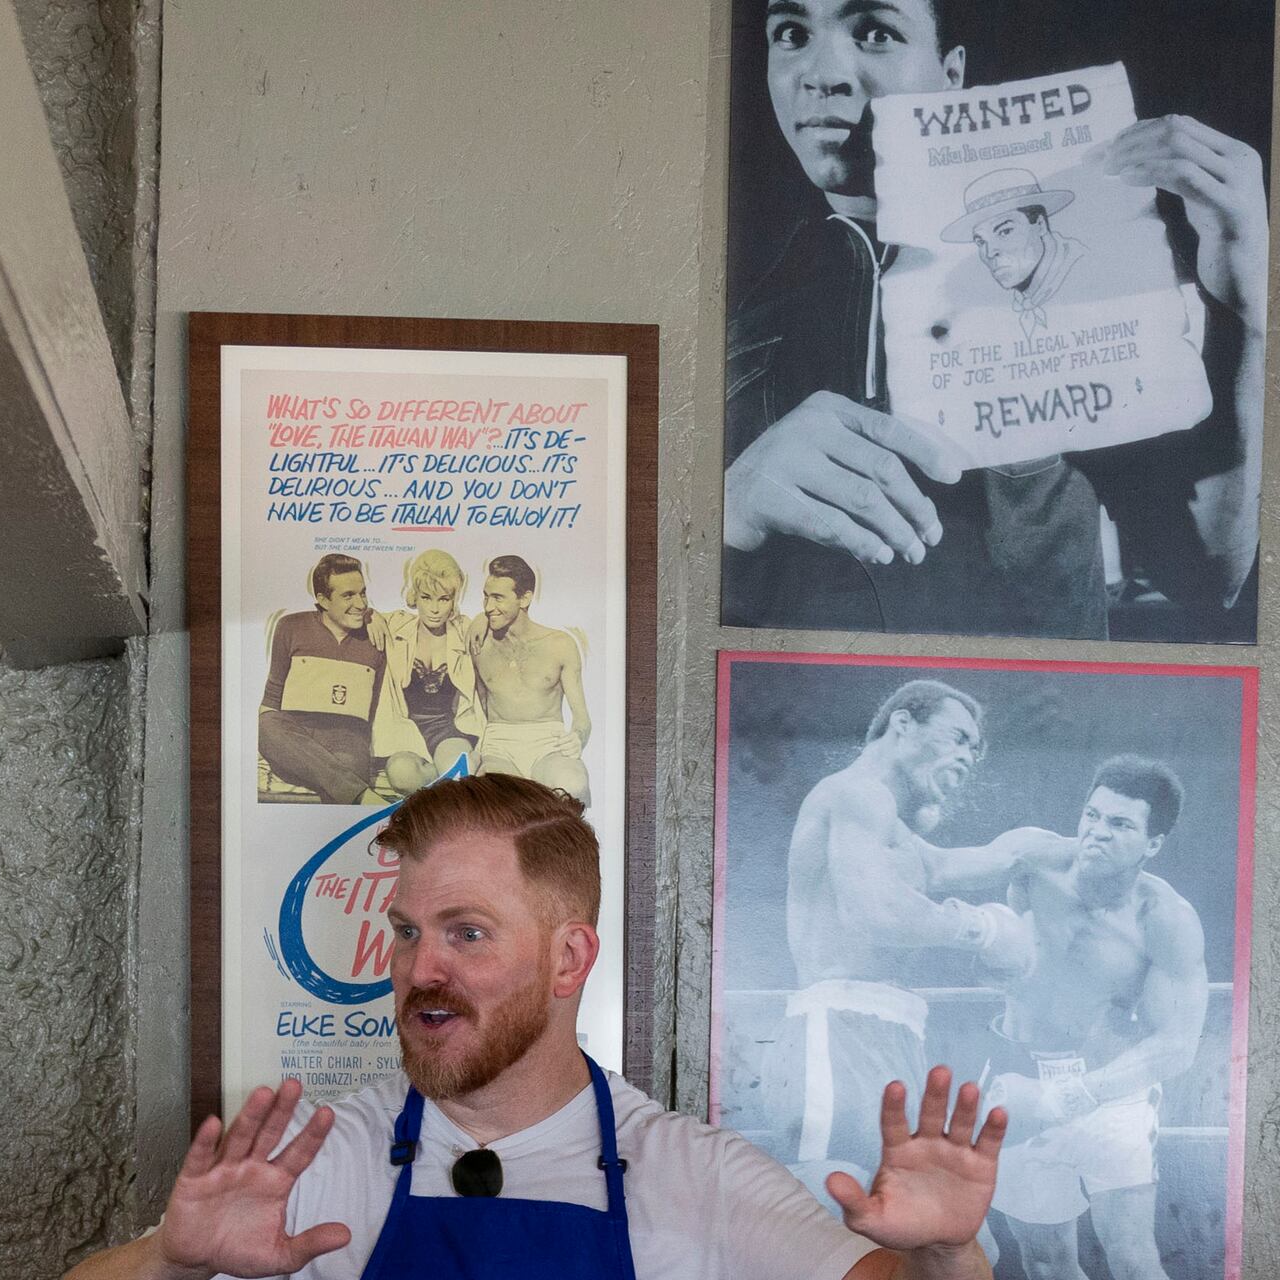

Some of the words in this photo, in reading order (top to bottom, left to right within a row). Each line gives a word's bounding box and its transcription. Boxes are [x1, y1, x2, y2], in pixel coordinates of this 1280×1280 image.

[913, 84, 1092, 136] WANTED
[930, 350, 963, 370] FOR
[969, 345, 1003, 364] THE
[1013, 335, 1070, 358] ILLEGAL
[1072, 319, 1141, 347] WHUPPIN'
[932, 373, 952, 390] OF
[963, 368, 995, 387] JOE
[1070, 342, 1141, 369] FRAZIER
[267, 394, 341, 421] WHAT'S
[345, 398, 371, 420] SO
[376, 398, 510, 425] DIFFERENT
[507, 402, 589, 425] ABOUT
[973, 381, 1114, 439] REWARD
[268, 422, 323, 450] "LOVE,
[329, 424, 366, 449] THE
[368, 424, 436, 449] ITALIAN
[378, 453, 419, 475] IT'S
[402, 479, 453, 500] AND
[463, 479, 501, 500] YOU
[509, 479, 577, 501] DON'T
[267, 501, 325, 523] HAVE
[329, 502, 352, 523] TO
[355, 503, 387, 524] BE
[391, 502, 461, 527] ITALIAN
[466, 505, 486, 526] TO
[489, 504, 552, 528] ENJOY
[548, 503, 582, 529] IT!
[315, 873, 350, 899] THE
[276, 1011, 336, 1037] ELKE
[281, 1056, 322, 1069] WALTER
[327, 1056, 362, 1069] CHIARI
[376, 1056, 403, 1070] SYLV
[306, 1073, 352, 1086] TOGNAZZI
